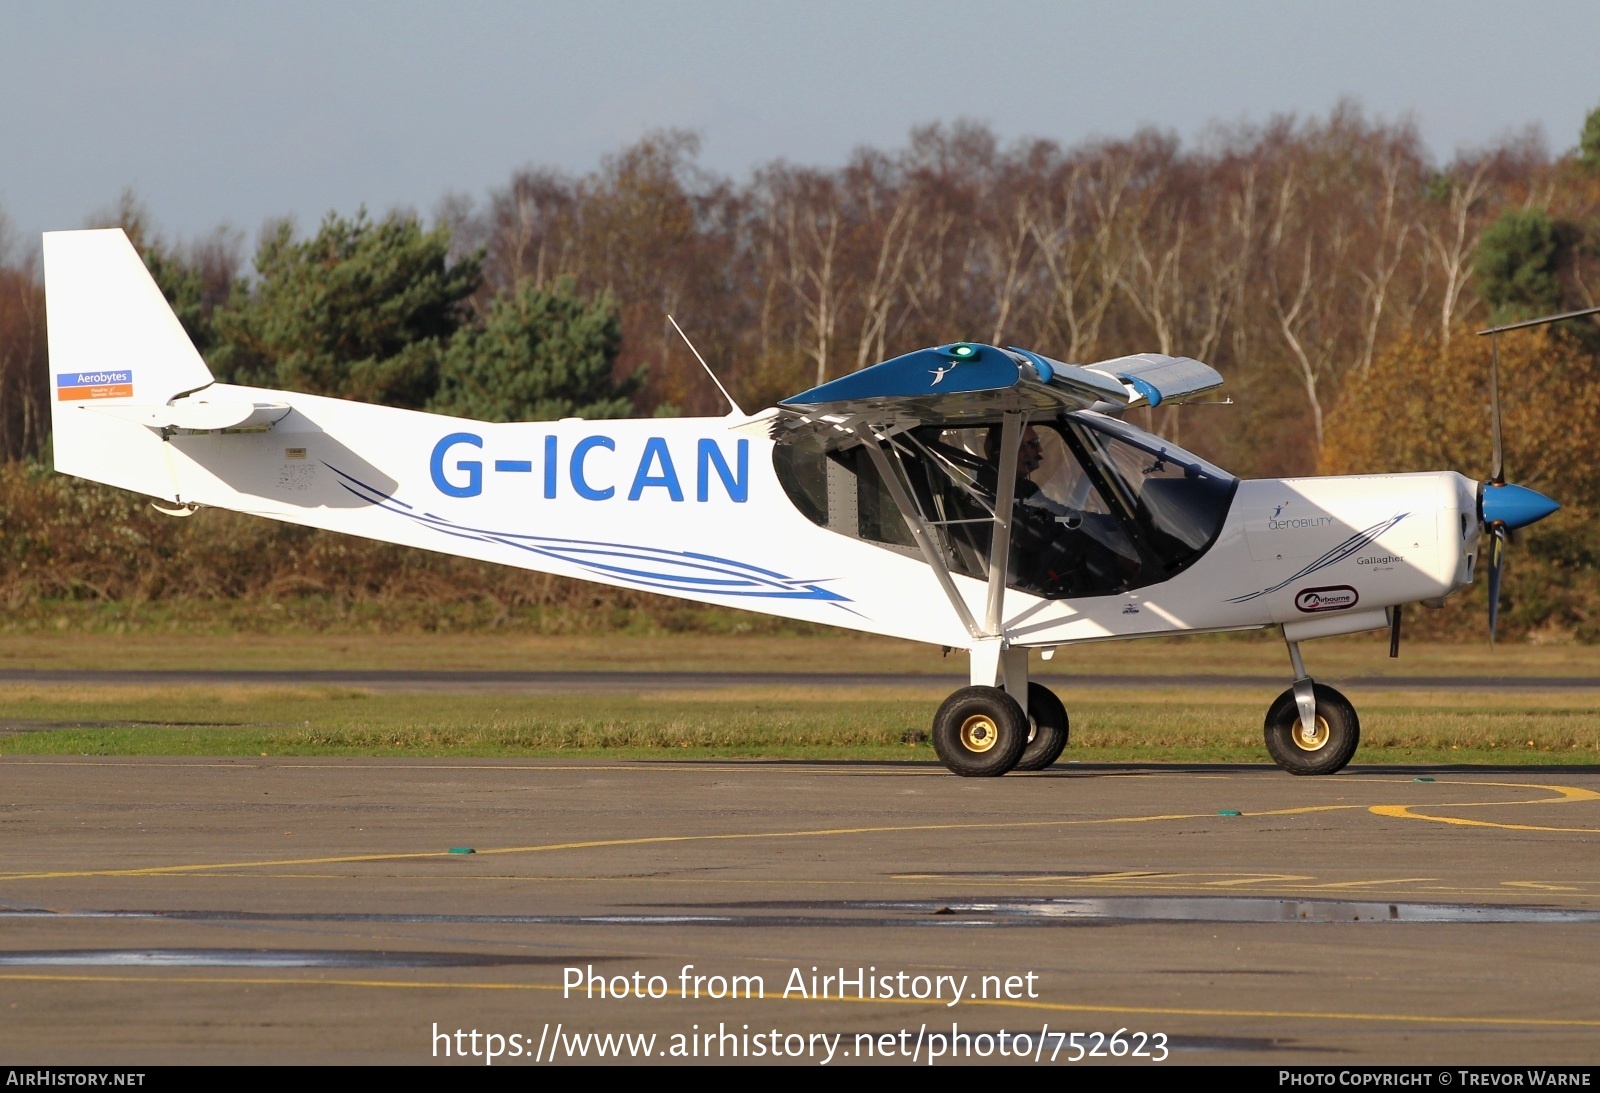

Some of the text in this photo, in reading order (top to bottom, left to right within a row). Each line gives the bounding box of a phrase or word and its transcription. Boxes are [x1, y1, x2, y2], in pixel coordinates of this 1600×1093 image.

[77, 371, 127, 384] Aerobytes
[430, 432, 749, 503] G-ICAN
[1356, 555, 1404, 565] Gallagher
[1312, 594, 1350, 604] Airbourne
